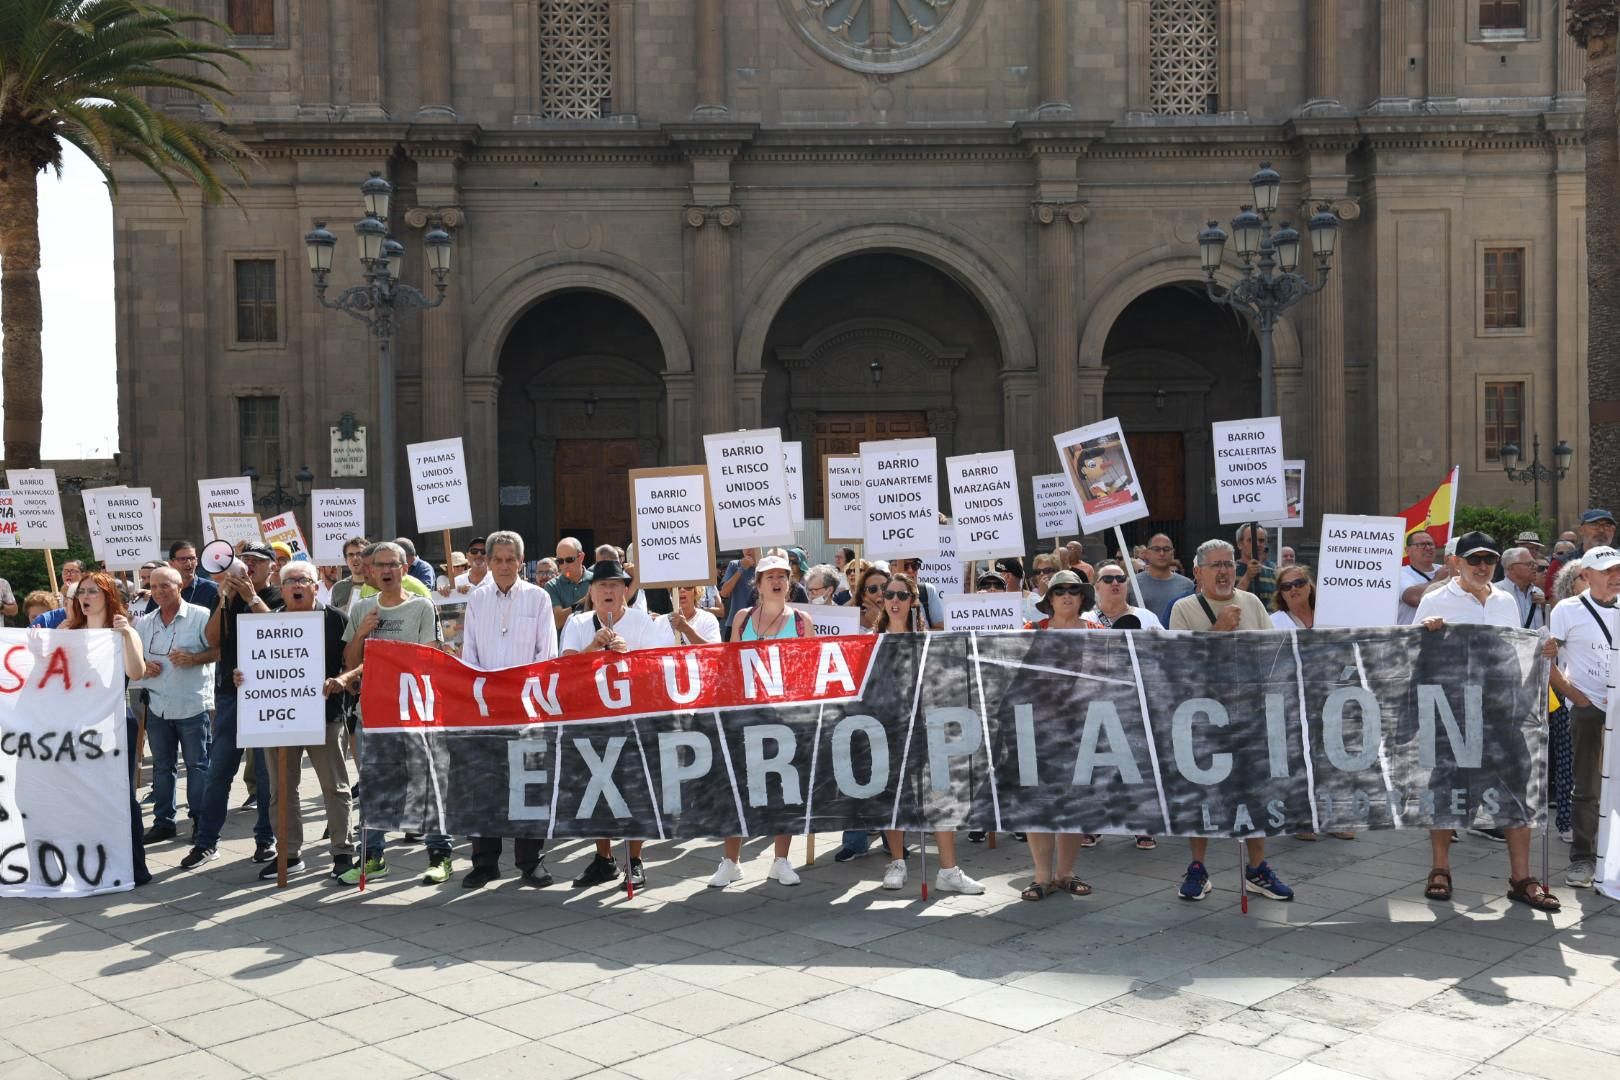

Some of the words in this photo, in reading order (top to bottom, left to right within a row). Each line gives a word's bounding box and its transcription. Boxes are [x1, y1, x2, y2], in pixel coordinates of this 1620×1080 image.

[1227, 431, 1265, 442] BARRIO
[722, 445, 764, 457] BARRIO
[1218, 446, 1277, 458] ESCALERITAS
[416, 457, 421, 465] 7
[423, 453, 456, 464] PALMAS
[878, 458, 919, 470] BARRIO
[422, 467, 454, 478] UNIDOS
[721, 466, 735, 476] EL
[736, 462, 769, 474] RISCO
[961, 465, 999, 478] BARRIO
[1228, 461, 1268, 473] UNIDOS
[416, 482, 444, 492] SOMOS
[445, 478, 462, 487] MÁS
[726, 480, 769, 493] UNIDOS
[865, 474, 933, 487] GUANARTEME
[1041, 481, 1065, 489] BARRIO
[1220, 478, 1254, 488] SOMOS
[1256, 474, 1277, 485] MÁS
[211, 488, 239, 497] BARRIO
[953, 480, 1011, 495] MARZAGÁN
[427, 494, 451, 505] LPGC
[650, 489, 687, 499] BARRIO
[878, 492, 922, 504] UNIDOS
[1232, 492, 1262, 504] LPGC
[108, 499, 139, 507] BARRIO
[207, 500, 246, 508] ARENALES
[325, 498, 357, 506] PALMAS
[718, 499, 756, 510] SOMOS
[758, 495, 781, 507] MÁS
[964, 498, 1003, 510] UNIDOS
[1042, 500, 1067, 508] UNIDOS
[107, 512, 117, 520] EL
[119, 511, 143, 519] RISCO
[323, 510, 353, 518] UNIDOS
[637, 506, 665, 515] LOMO
[666, 504, 702, 513] BLANCO
[869, 511, 907, 522] SOMOS
[909, 507, 932, 519] MÁS
[1038, 510, 1059, 518] SOMOS
[27, 520, 48, 528] LPGC
[344, 520, 360, 528] MÁS
[732, 515, 766, 528] LPGC
[958, 515, 991, 526] SOMOS
[993, 511, 1014, 522] MÁS
[1045, 519, 1064, 527] LPGC
[111, 524, 144, 532] UNIDOS
[651, 520, 690, 530] UNIDOS
[325, 533, 348, 541] LPGC
[641, 537, 677, 547] SOMOS
[679, 533, 702, 545] MÁS
[882, 528, 914, 540] LPGC
[970, 529, 1000, 542] LPGC
[1328, 529, 1348, 539] LAS
[1350, 530, 1395, 541] PALMAS
[116, 548, 141, 557] LPGC
[1327, 545, 1364, 554] SIEMPRE
[1364, 547, 1393, 555] LIMPIA
[658, 552, 680, 561] LPGC
[919, 563, 952, 571] UNIDOS
[1335, 559, 1383, 571] UNIDOS
[941, 575, 959, 584] MÁS
[1323, 577, 1363, 587] SOMOS
[1366, 577, 1392, 589] MÁS
[951, 609, 969, 619] LAS
[972, 607, 1014, 618] PALMAS
[256, 628, 304, 639] BARRIO
[251, 649, 267, 660] LA
[270, 648, 309, 659] ISLETA
[256, 667, 305, 680] UNIDOS
[399, 642, 857, 722] NINGUNA
[244, 688, 287, 700] SOMOS
[290, 685, 317, 698] MÁS
[259, 708, 296, 721] LPGC
[508, 666, 1484, 821] EXPROPIACIÓN
[1201, 799, 1289, 832] LAS
